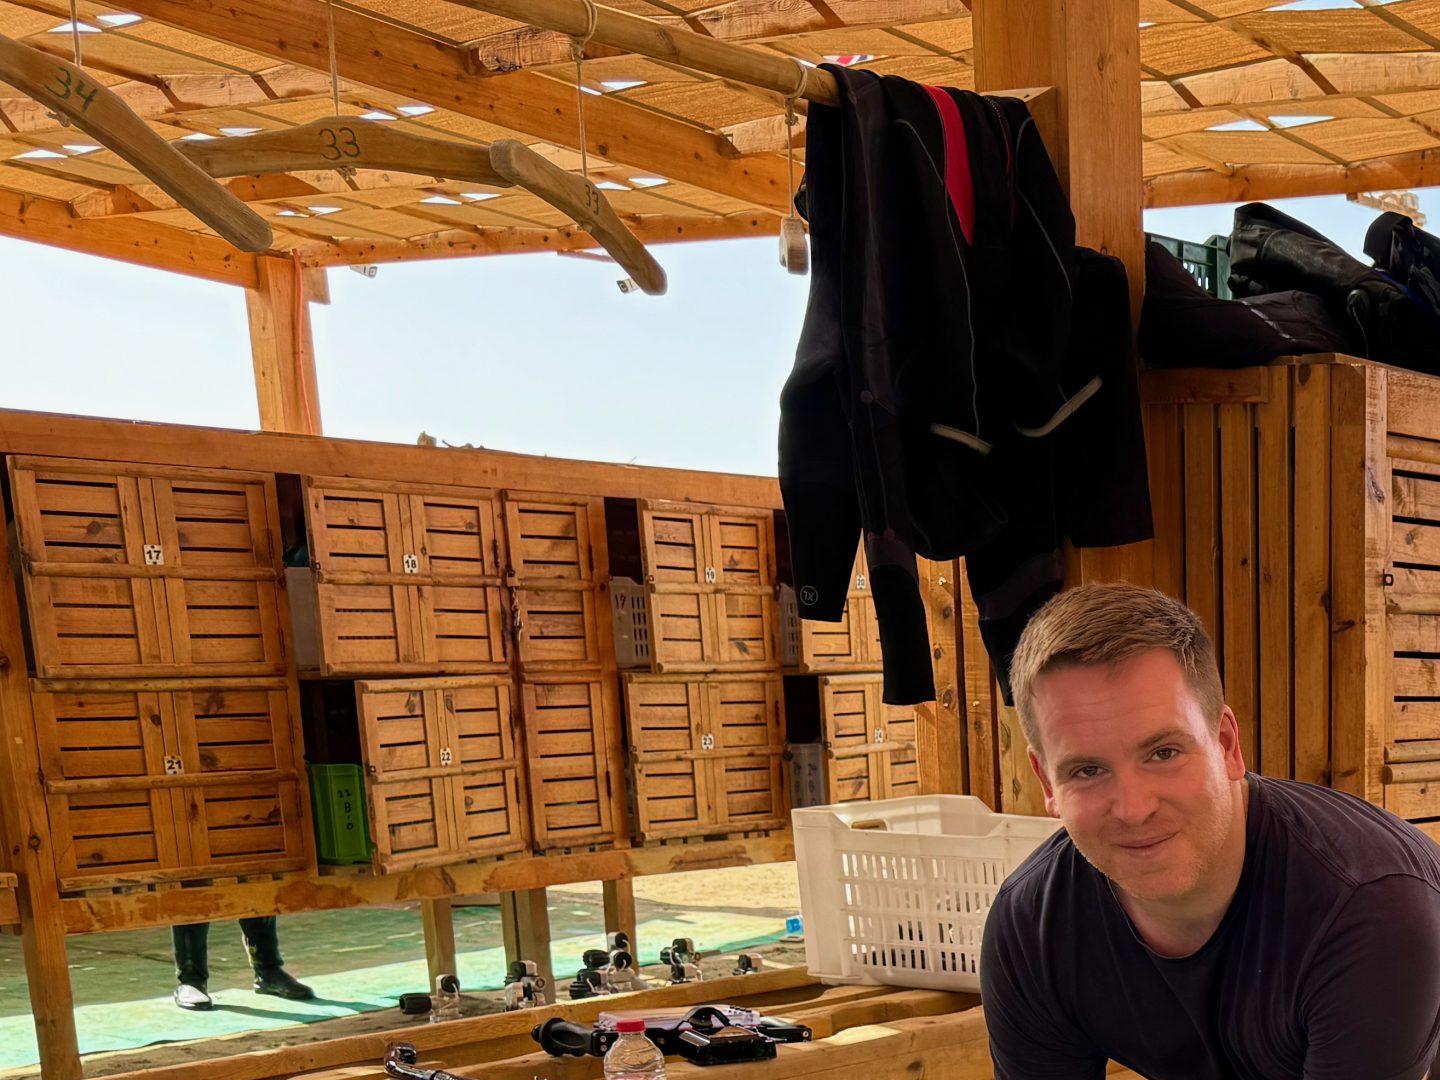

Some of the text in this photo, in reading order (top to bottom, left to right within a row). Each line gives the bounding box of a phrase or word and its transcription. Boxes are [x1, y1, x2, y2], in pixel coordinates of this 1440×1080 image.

[45, 66, 98, 112] 34
[319, 127, 361, 160] 33
[146, 549, 161, 560] 17
[405, 559, 417, 569] 18
[803, 590, 815, 601] XL
[703, 737, 713, 746] 23
[441, 752, 451, 761] 22
[167, 760, 182, 770] 21
